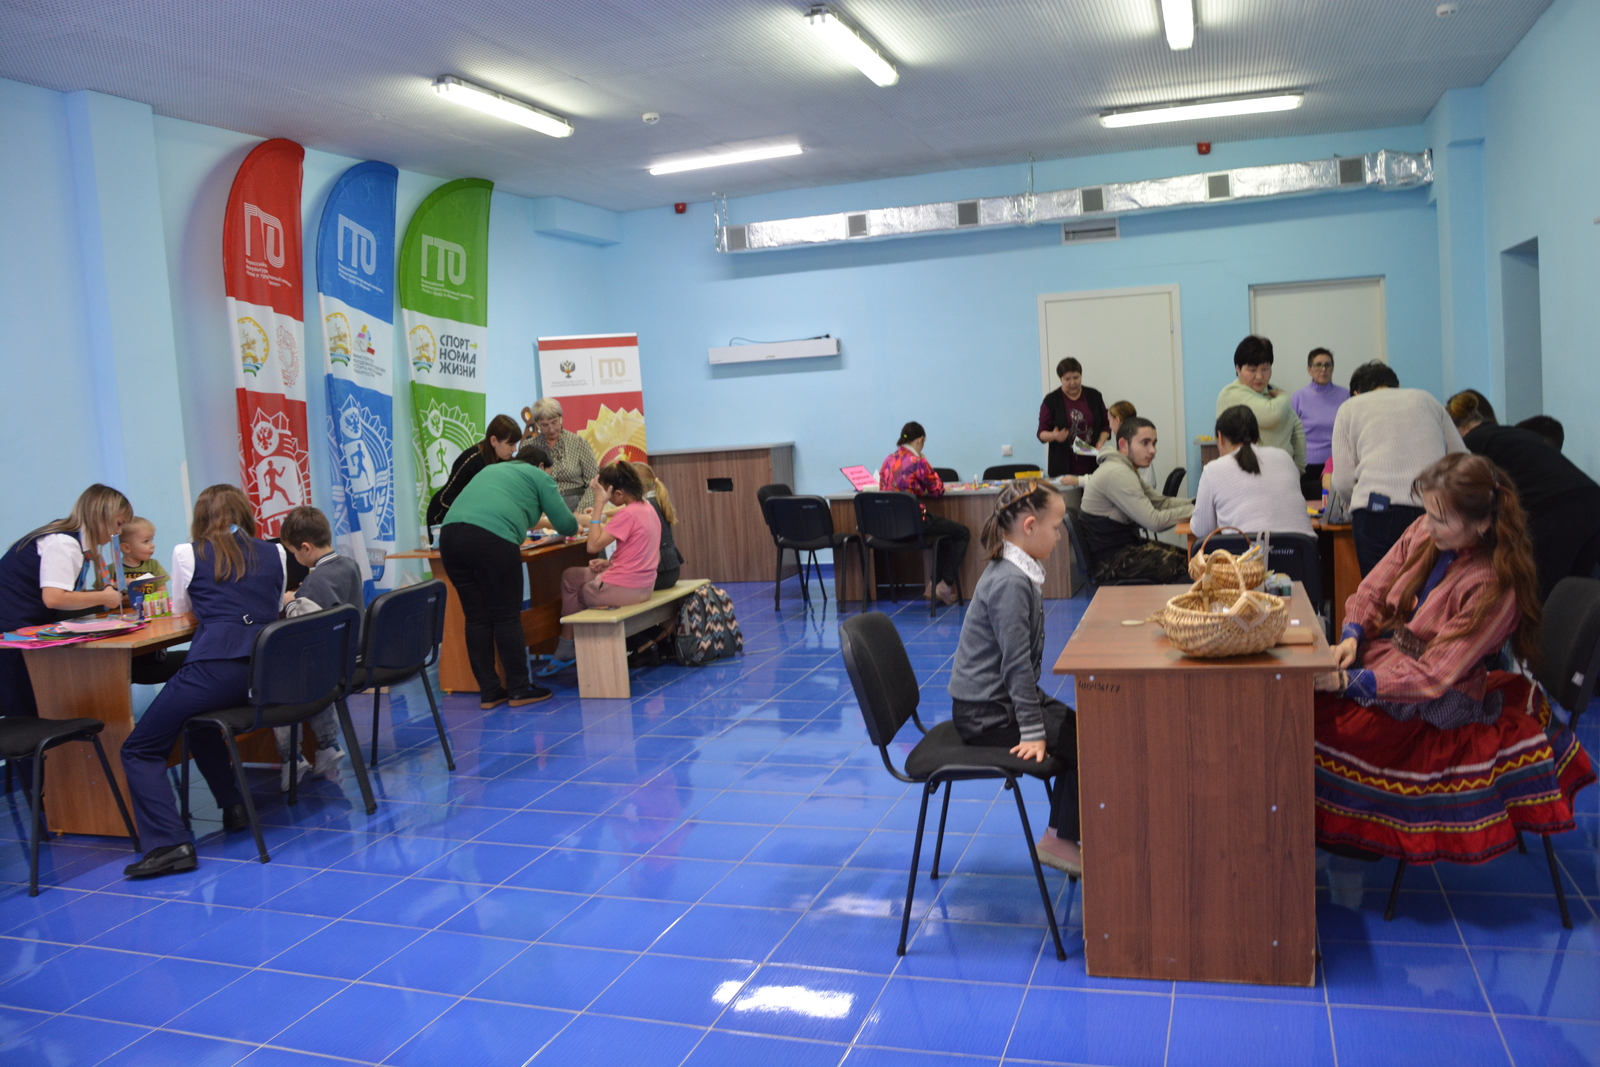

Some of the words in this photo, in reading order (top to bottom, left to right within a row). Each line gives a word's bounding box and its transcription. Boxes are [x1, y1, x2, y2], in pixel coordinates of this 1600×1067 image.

[338, 213, 377, 275] ГТО
[421, 233, 466, 286] ГТО
[439, 334, 470, 351] СПОРТ
[439, 347, 476, 365] НОРМА
[439, 361, 476, 378] ЖИЗНИ
[598, 357, 626, 378] ГТО
